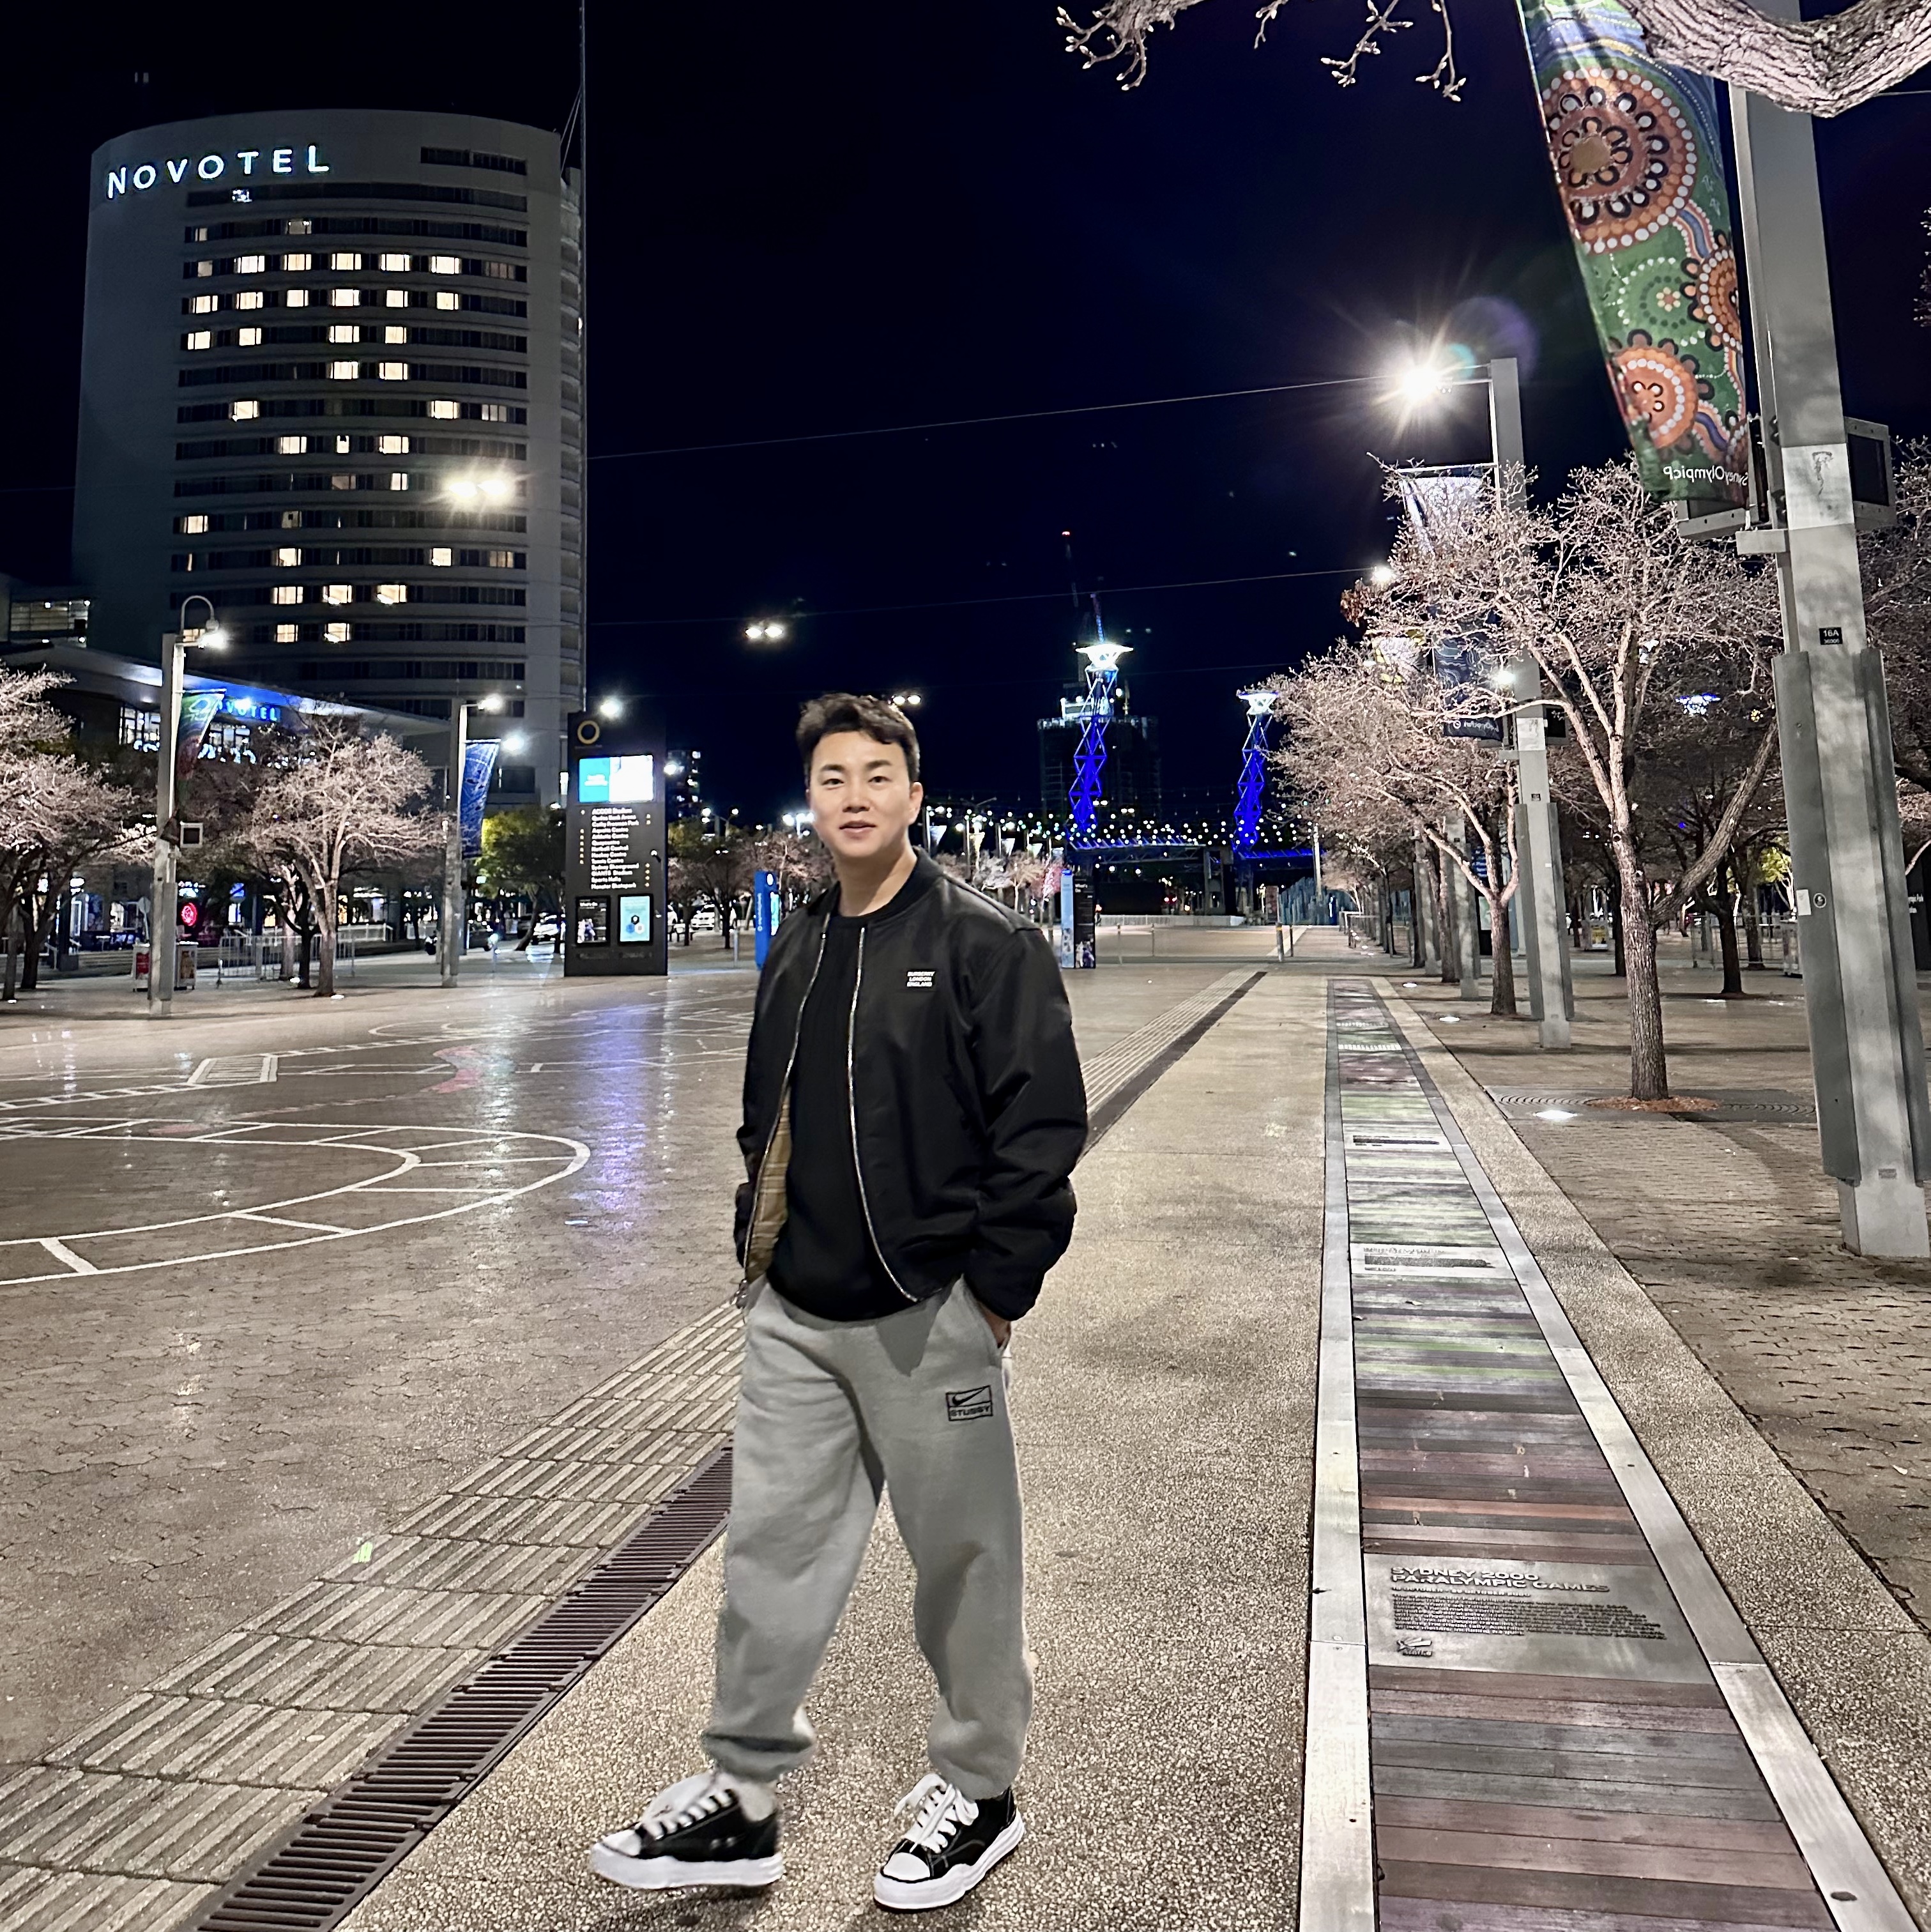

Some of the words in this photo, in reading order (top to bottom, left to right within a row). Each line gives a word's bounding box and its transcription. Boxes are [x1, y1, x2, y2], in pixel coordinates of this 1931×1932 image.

[107, 145, 330, 199] NOVOTEL
[1391, 1567, 1476, 1578] SYDNEY
[1481, 1571, 1539, 1581] 2000
[1391, 1574, 1527, 1589] PARALYMPIC
[1532, 1581, 1610, 1593] GAMES
